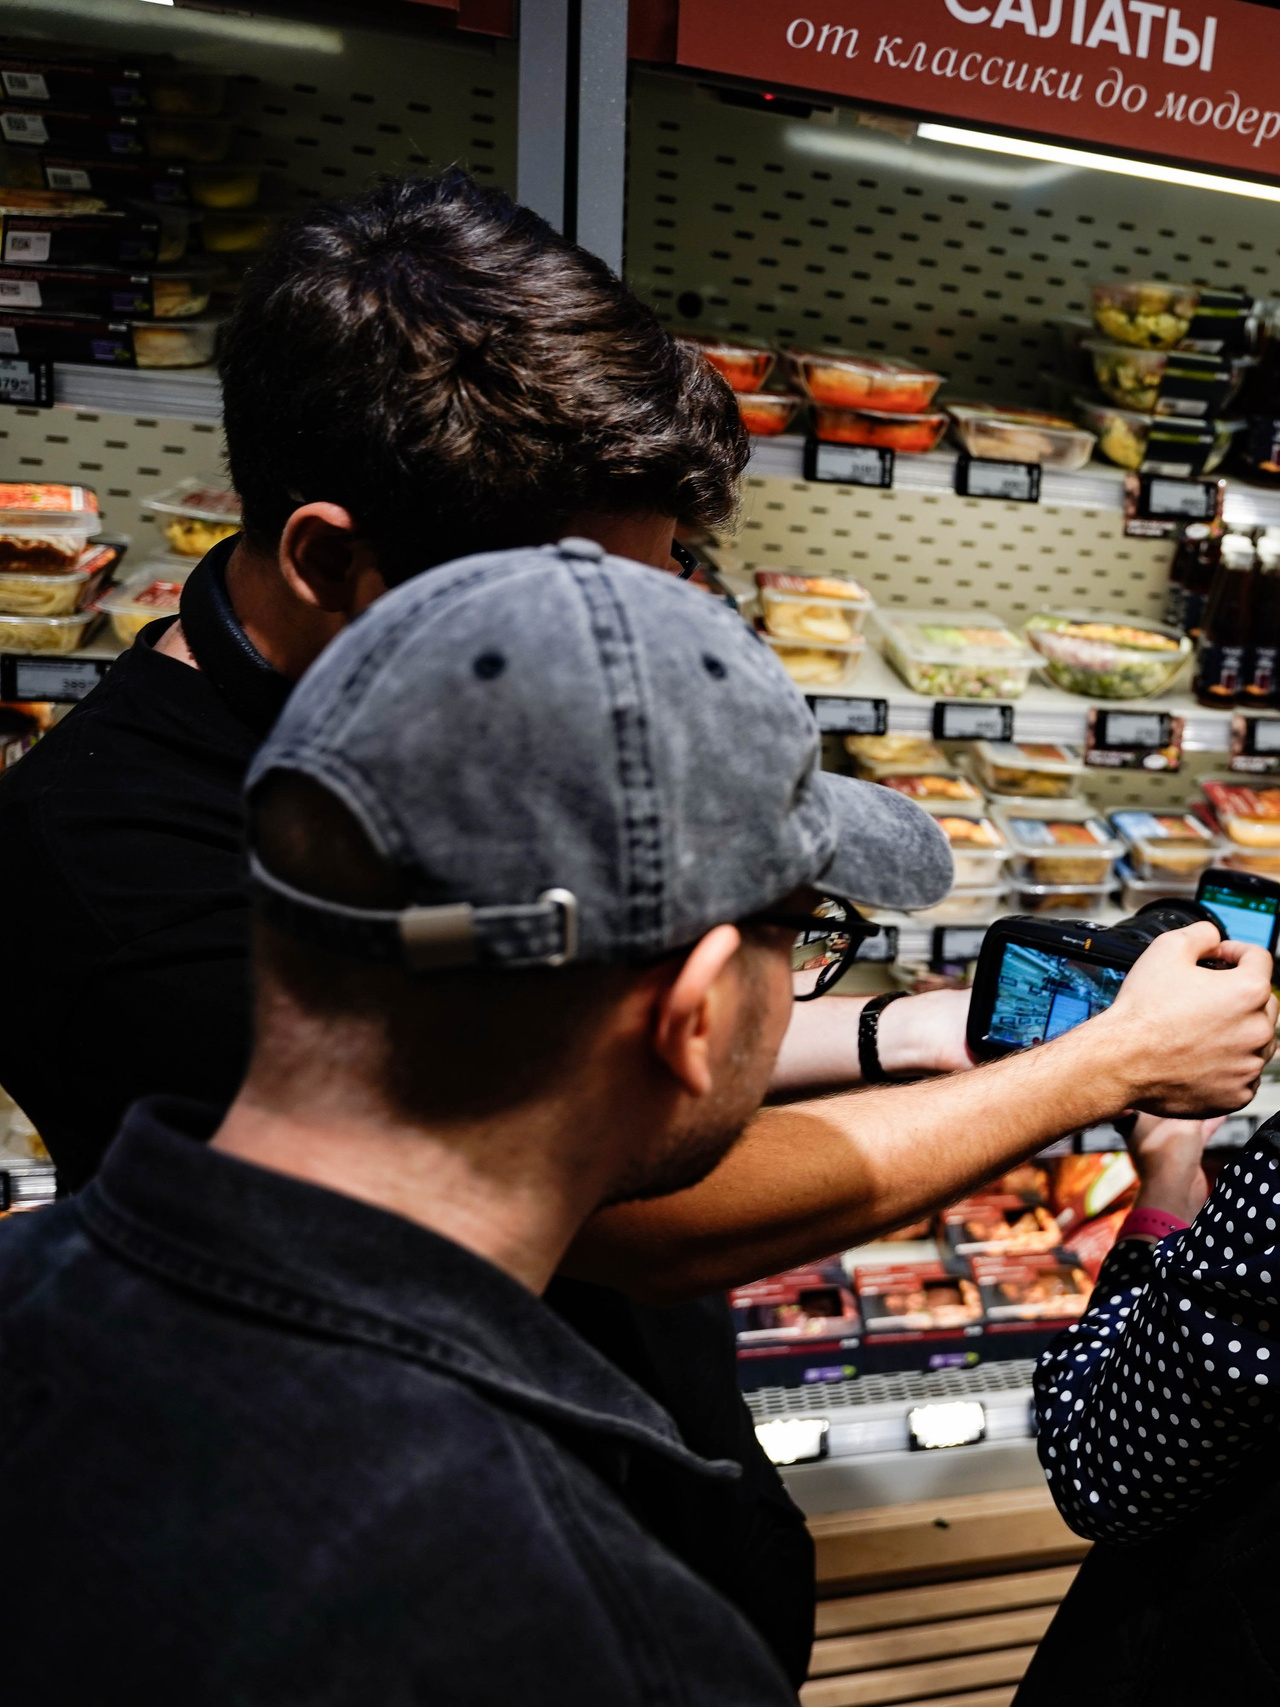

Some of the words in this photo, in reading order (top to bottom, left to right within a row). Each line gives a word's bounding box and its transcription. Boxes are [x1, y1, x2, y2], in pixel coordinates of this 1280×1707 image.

[786, 17, 860, 60] от
[873, 35, 1084, 102] классики
[1094, 66, 1148, 113] до
